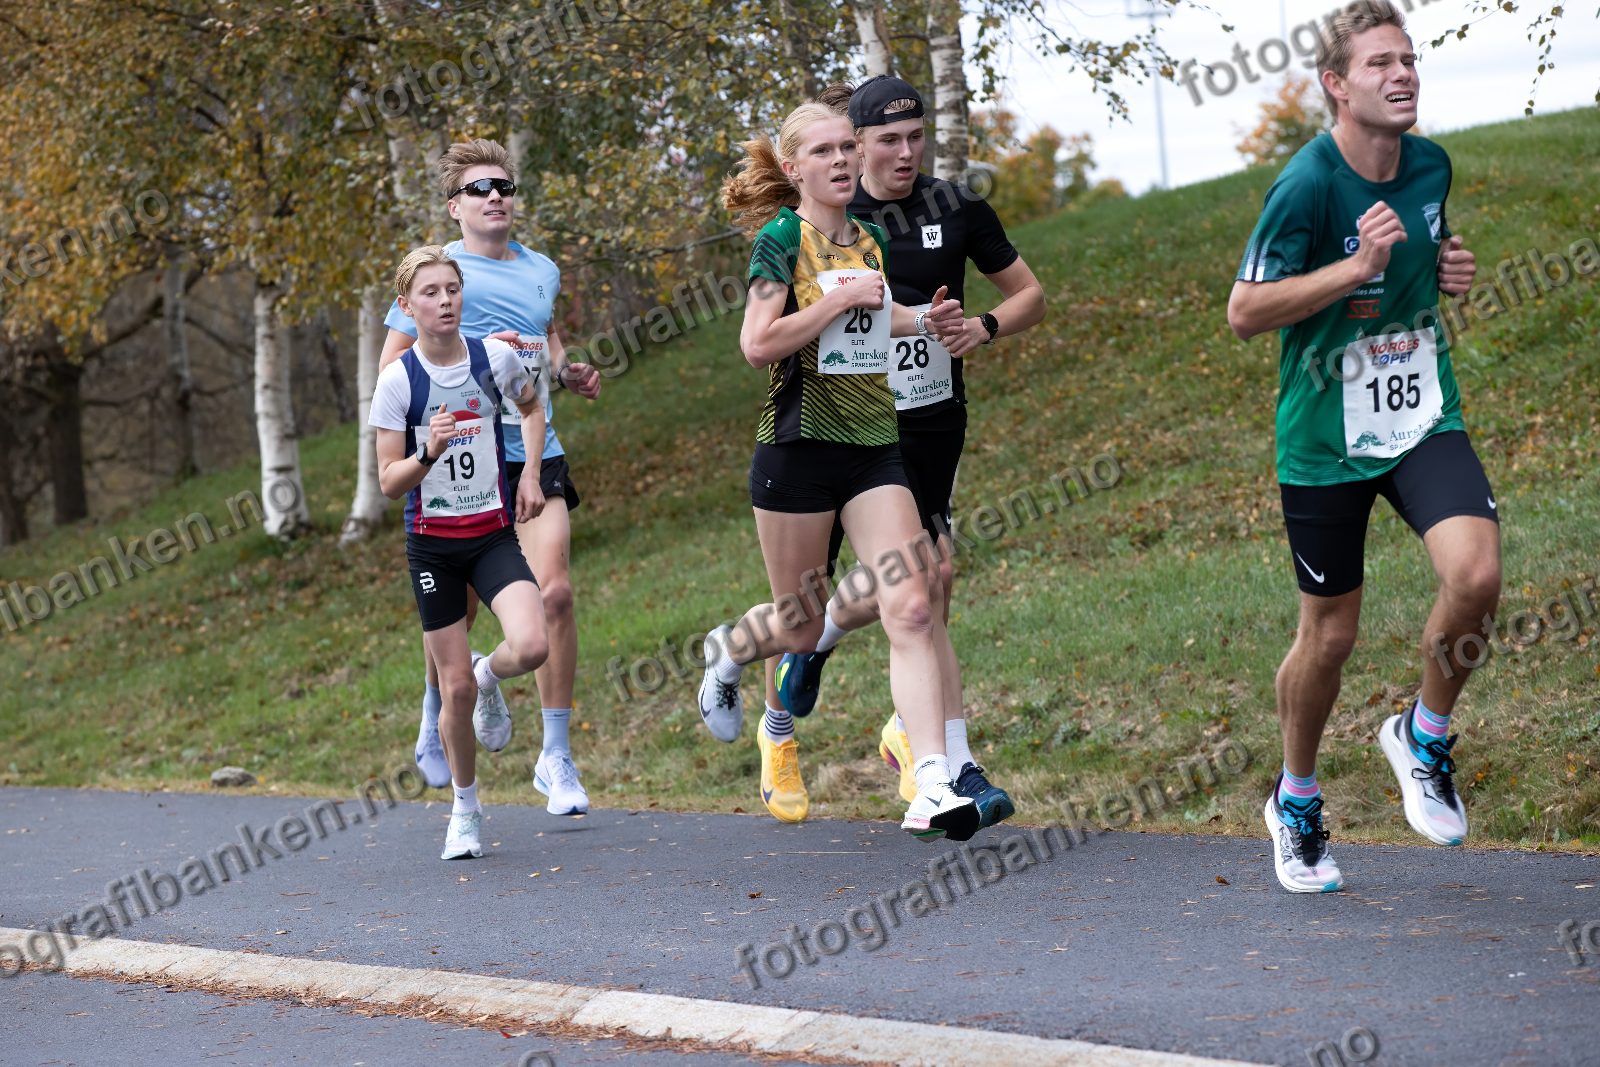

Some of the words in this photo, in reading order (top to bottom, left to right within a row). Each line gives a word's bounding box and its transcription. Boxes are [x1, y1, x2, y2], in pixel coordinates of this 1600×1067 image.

[844, 307, 873, 335] 26
[1367, 339, 1420, 354] NORGES
[851, 348, 888, 363] Aurskog
[895, 338, 930, 372] 28
[1371, 351, 1413, 366] LØPET
[907, 373, 925, 382] ELITE
[909, 378, 950, 396] Aurskog
[1365, 372, 1421, 413] 185
[443, 451, 475, 481] 19
[453, 484, 470, 492] ELITE
